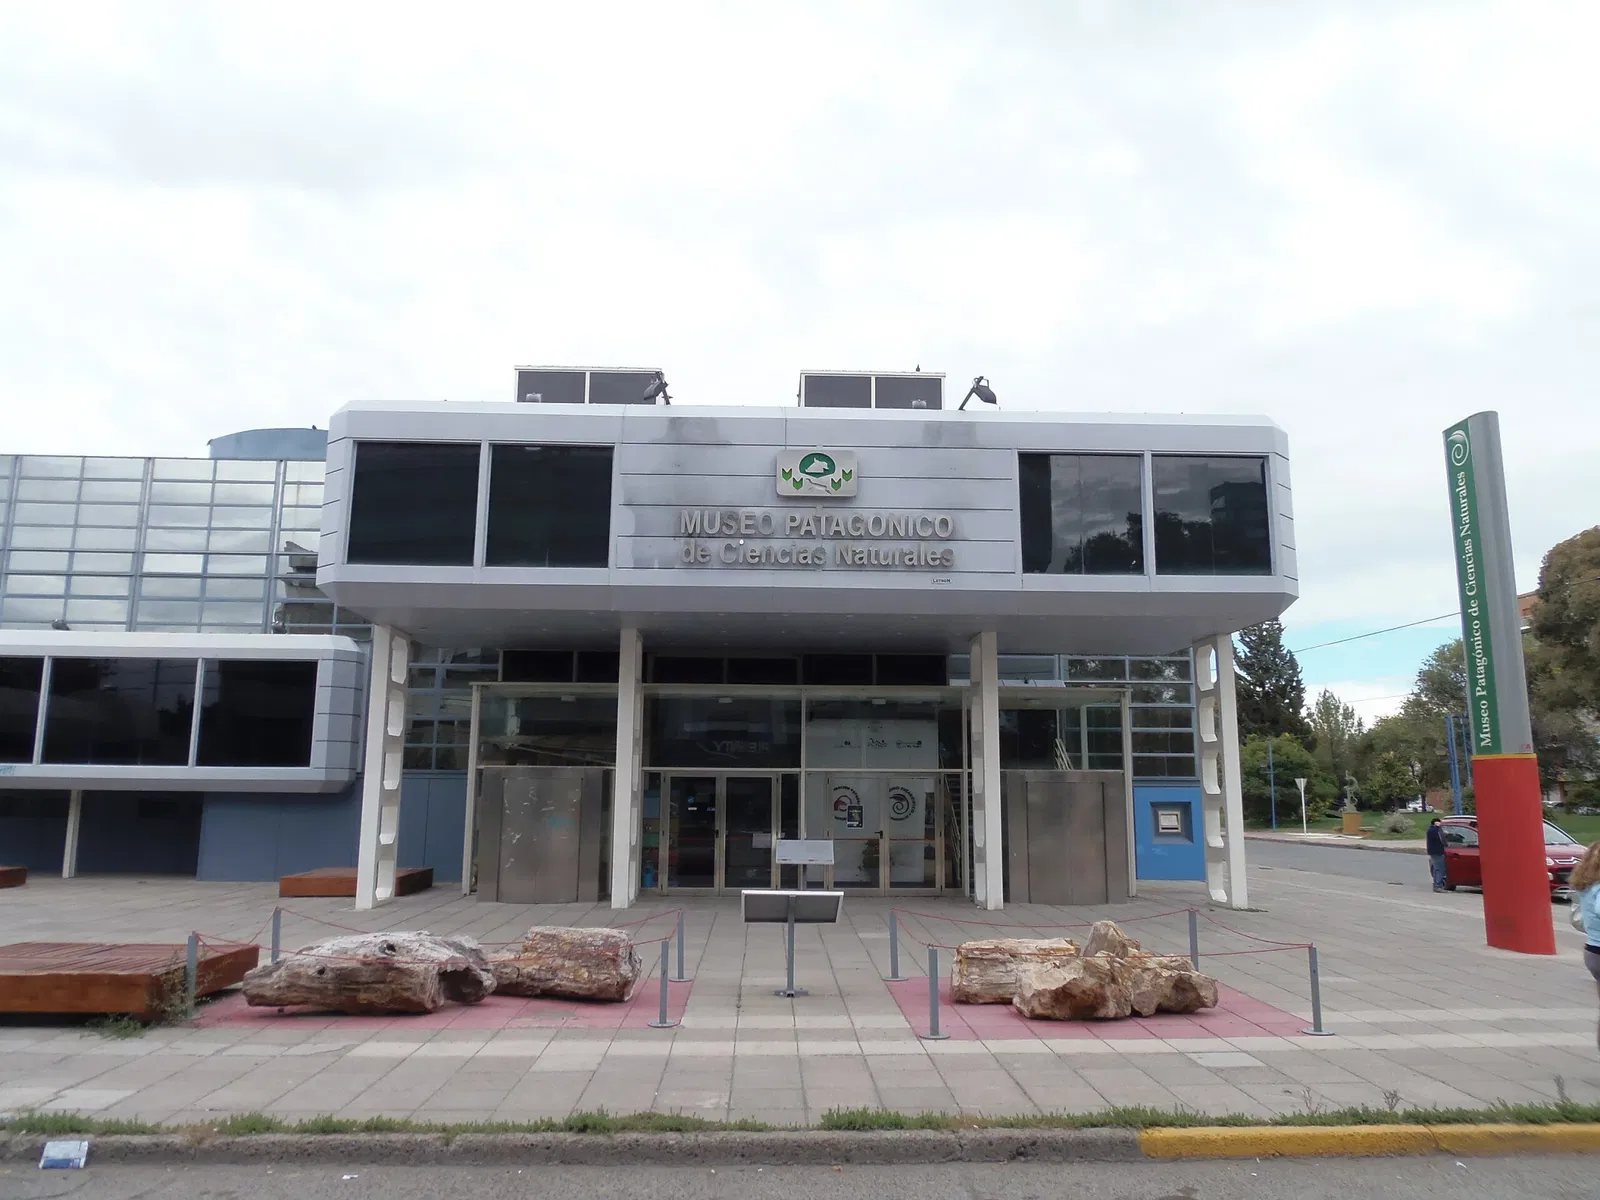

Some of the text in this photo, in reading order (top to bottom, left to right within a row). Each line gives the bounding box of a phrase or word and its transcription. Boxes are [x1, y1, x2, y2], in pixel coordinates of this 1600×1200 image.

[680, 509, 955, 539] MUSEO PATAGONICO
[681, 539, 954, 568] de Ciencias Naturales
[1455, 471, 1492, 748] Museo Patagónico de Ciencias Naturales
